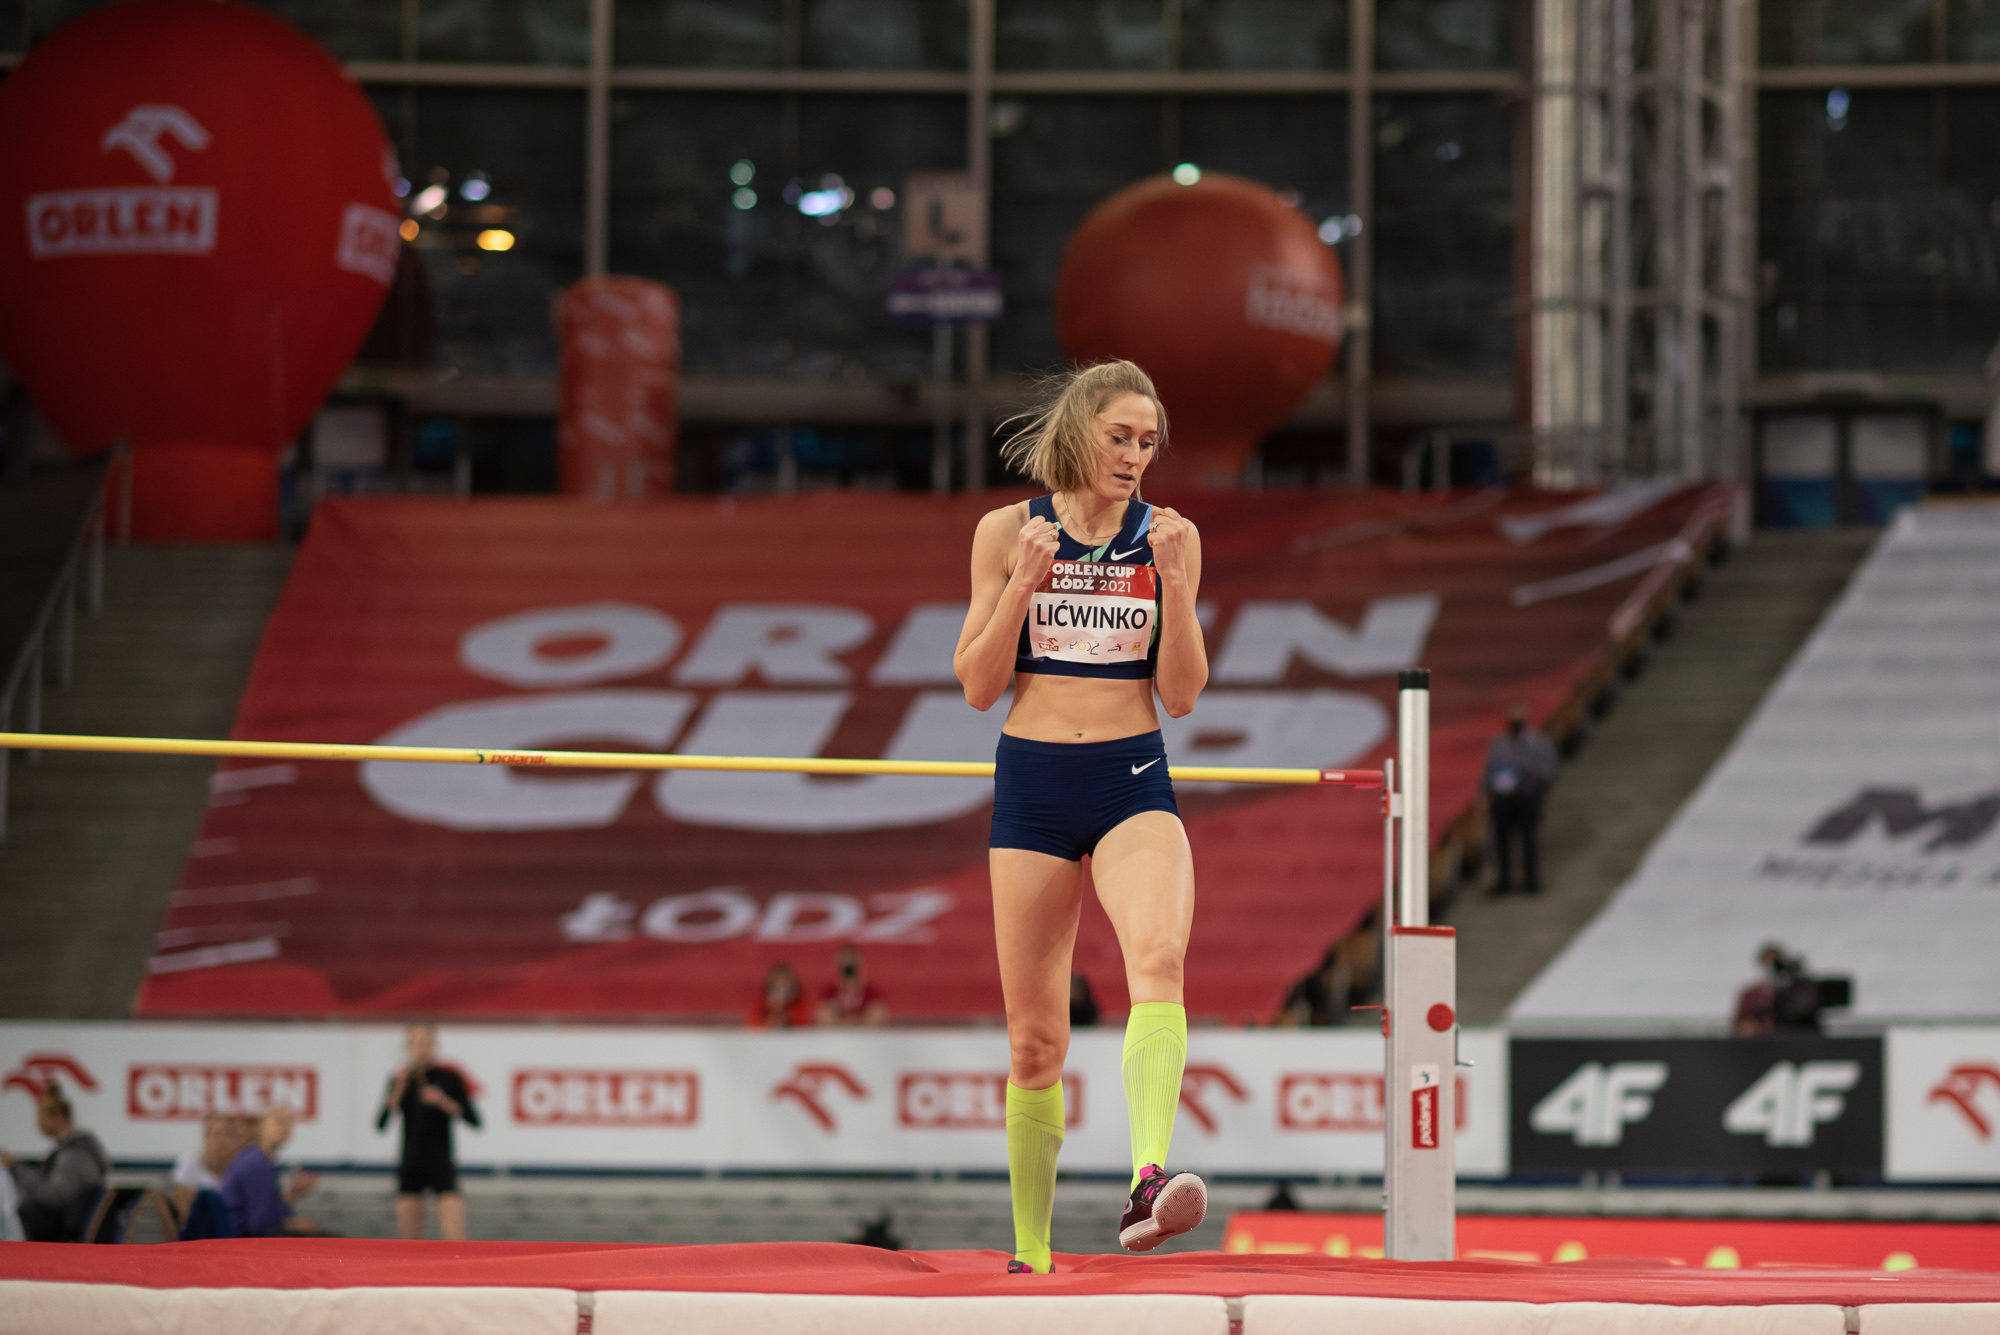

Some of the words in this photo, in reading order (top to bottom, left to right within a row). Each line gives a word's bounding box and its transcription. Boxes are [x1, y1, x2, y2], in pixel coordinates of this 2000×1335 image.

[40, 204, 200, 242] ORLEN
[1051, 576, 1095, 591] ŁÓDŹ
[1100, 580, 1131, 593] 2021
[1052, 563, 1103, 577] ORLEN
[1106, 565, 1136, 579] CUP
[1037, 600, 1148, 630] LIĆWINKO
[490, 754, 547, 766] polanik
[138, 1072, 307, 1112] ORLEN
[521, 1079, 693, 1118] ORLEN
[1530, 1062, 1668, 1146] 4F
[1722, 1062, 1860, 1146] 4F
[1417, 1089, 1434, 1146] polanik
